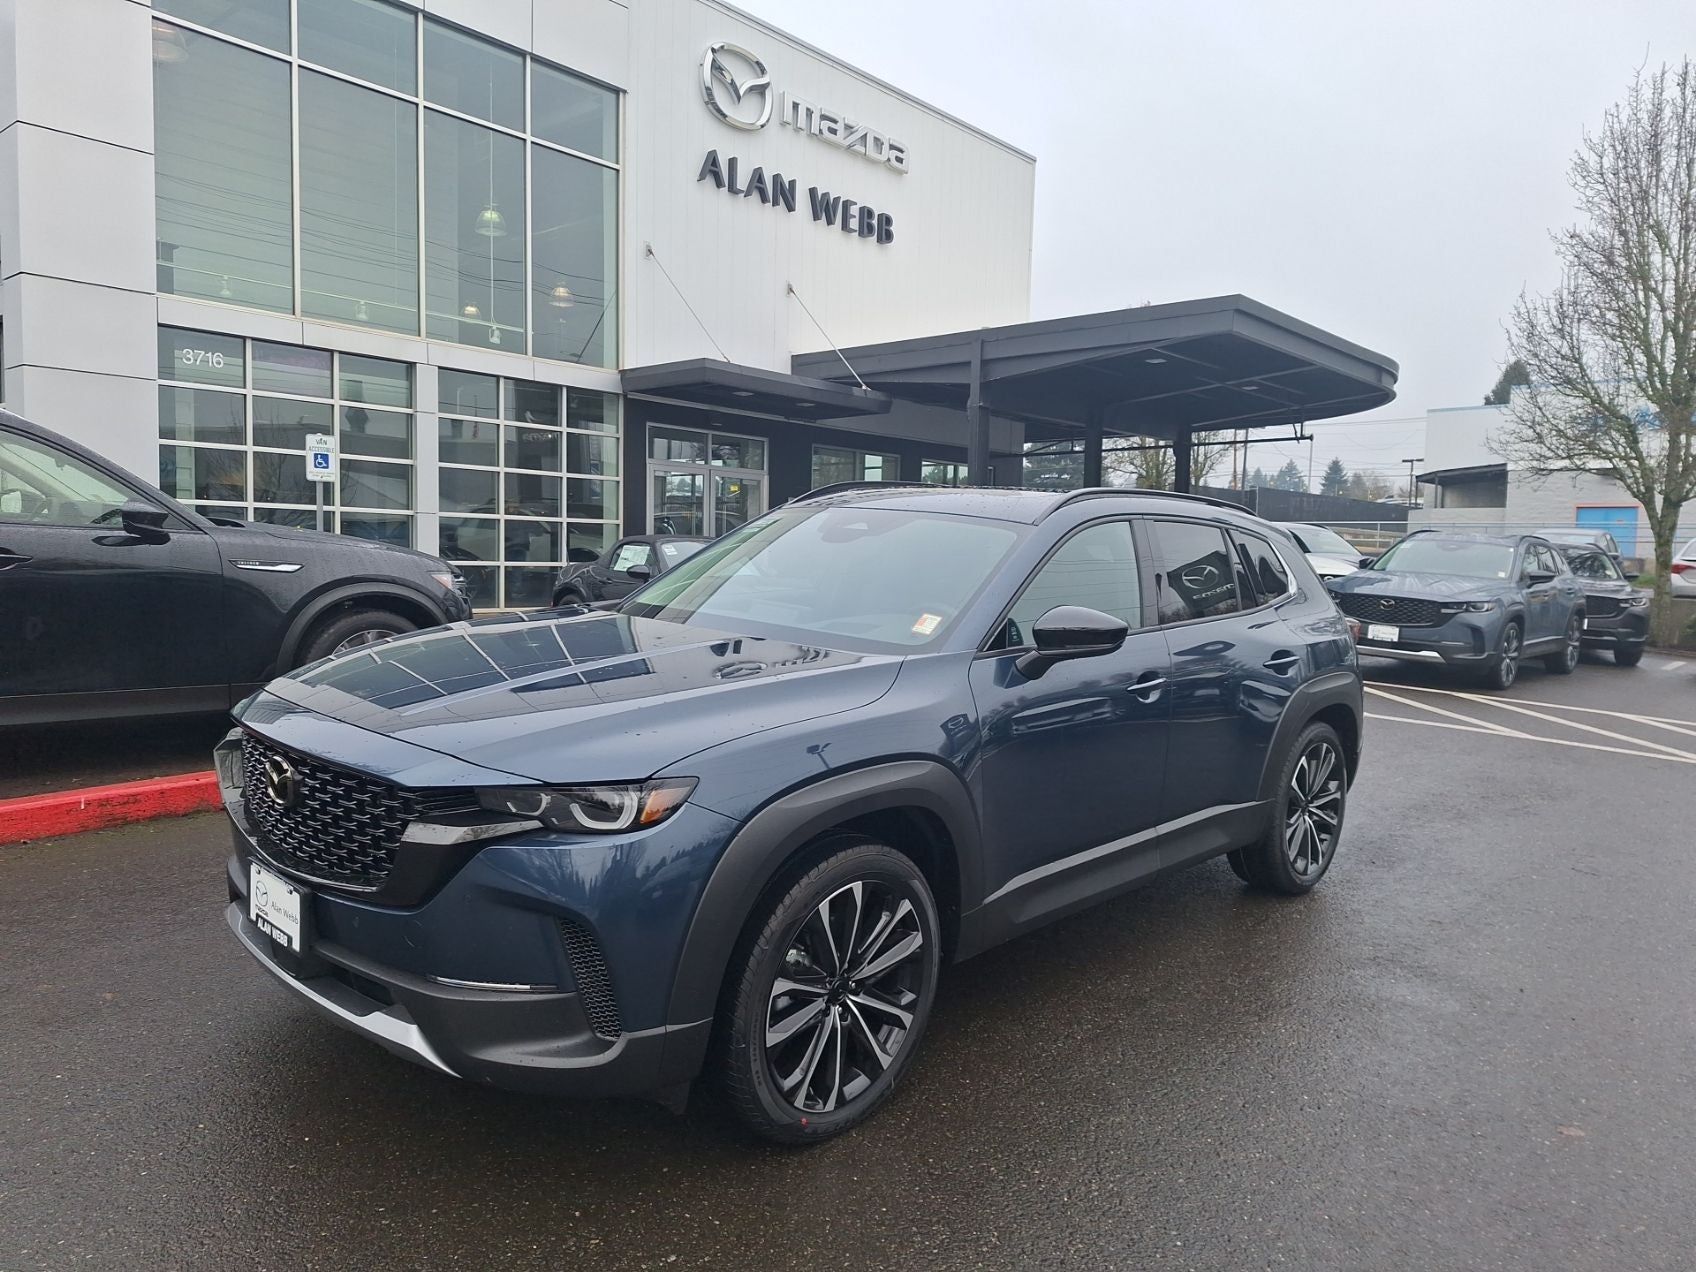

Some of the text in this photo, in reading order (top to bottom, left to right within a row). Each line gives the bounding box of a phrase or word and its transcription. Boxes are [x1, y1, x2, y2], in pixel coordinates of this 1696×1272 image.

[780, 90, 909, 174] mazda
[697, 149, 894, 244] ALAN WEBB
[182, 348, 224, 368] 3716
[315, 438, 328, 446] VAN
[257, 917, 288, 947] ALAN WEBB
